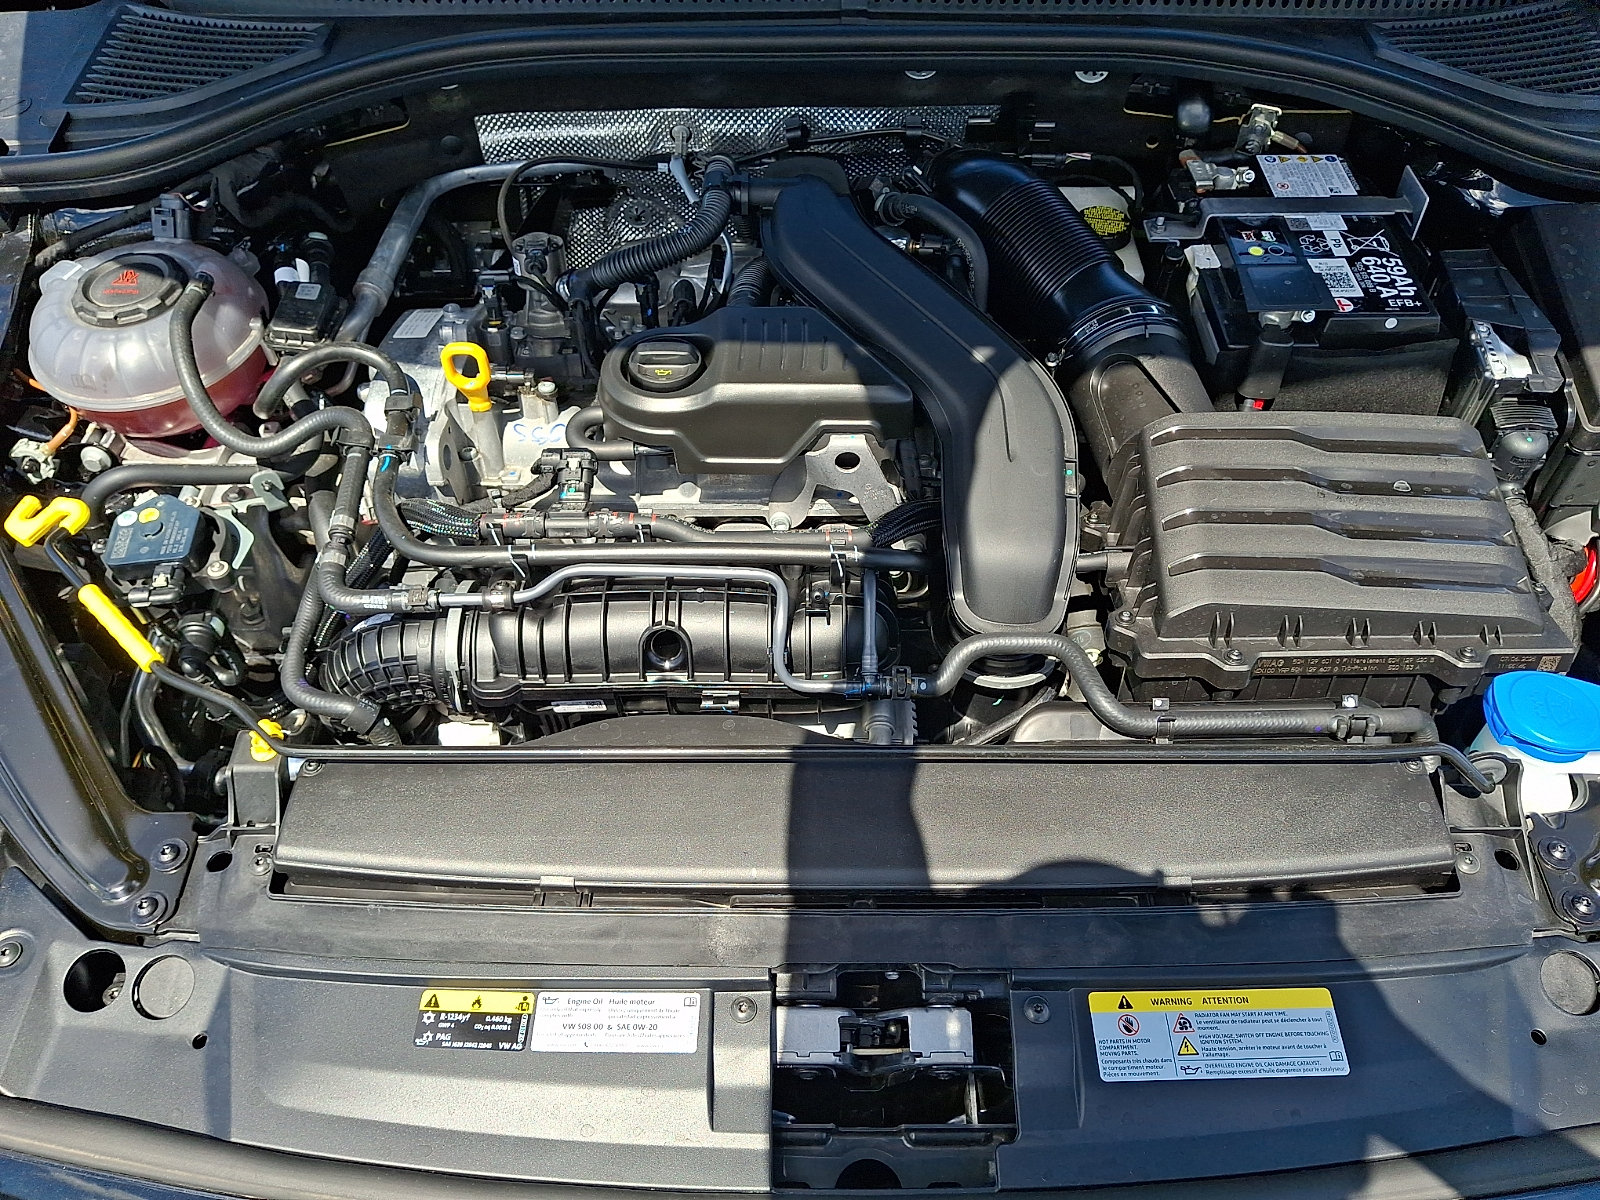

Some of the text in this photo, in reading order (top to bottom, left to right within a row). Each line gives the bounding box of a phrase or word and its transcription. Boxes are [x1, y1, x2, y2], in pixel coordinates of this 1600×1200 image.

[1330, 238, 1343, 249] Pb
[1361, 256, 1391, 283] 640
[1376, 286, 1399, 298] A
[1381, 257, 1417, 296] 59Ah
[1387, 299, 1422, 307] EFB+
[567, 998, 592, 1006] Engine
[1150, 996, 1250, 1006] WARNING ATTENTION
[440, 1013, 471, 1023] R-1234yf
[593, 1023, 604, 1031] 00
[616, 1023, 631, 1031] SAE
[632, 1023, 658, 1031] 0W-20
[435, 1033, 452, 1041] PAG
[498, 1042, 511, 1050] VW
[1276, 1067, 1302, 1075] dangereux
